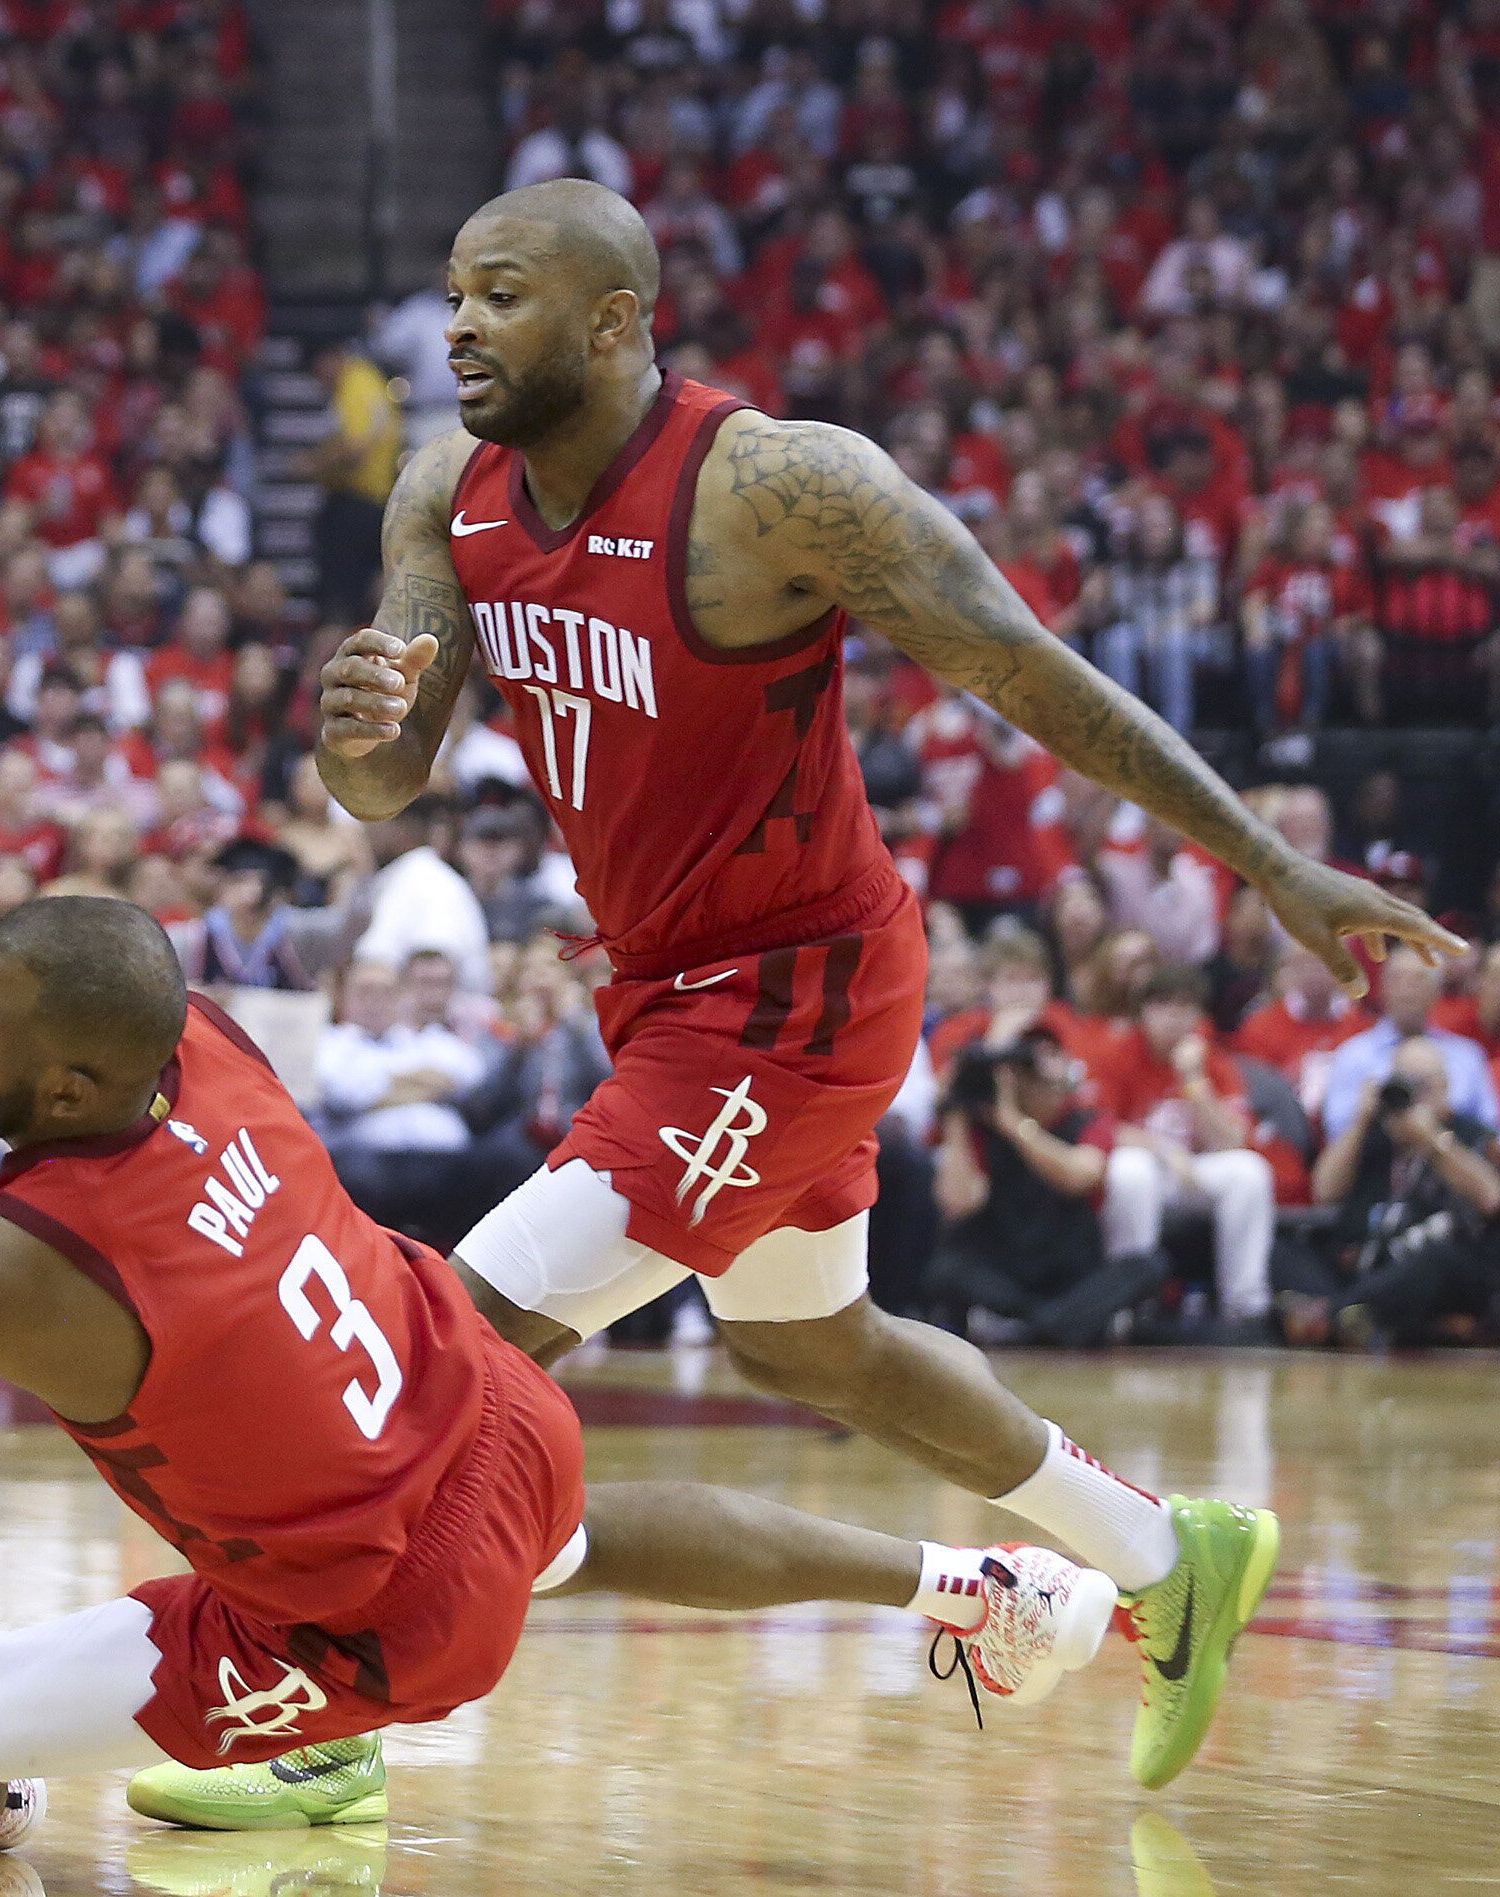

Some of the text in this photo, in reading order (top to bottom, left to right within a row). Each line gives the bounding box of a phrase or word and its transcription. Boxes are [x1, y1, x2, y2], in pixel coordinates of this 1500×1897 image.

[468, 602, 658, 719] OUSTON
[522, 685, 591, 811] 17
[187, 1127, 281, 1258] PAUL
[278, 1233, 403, 1440] 3
